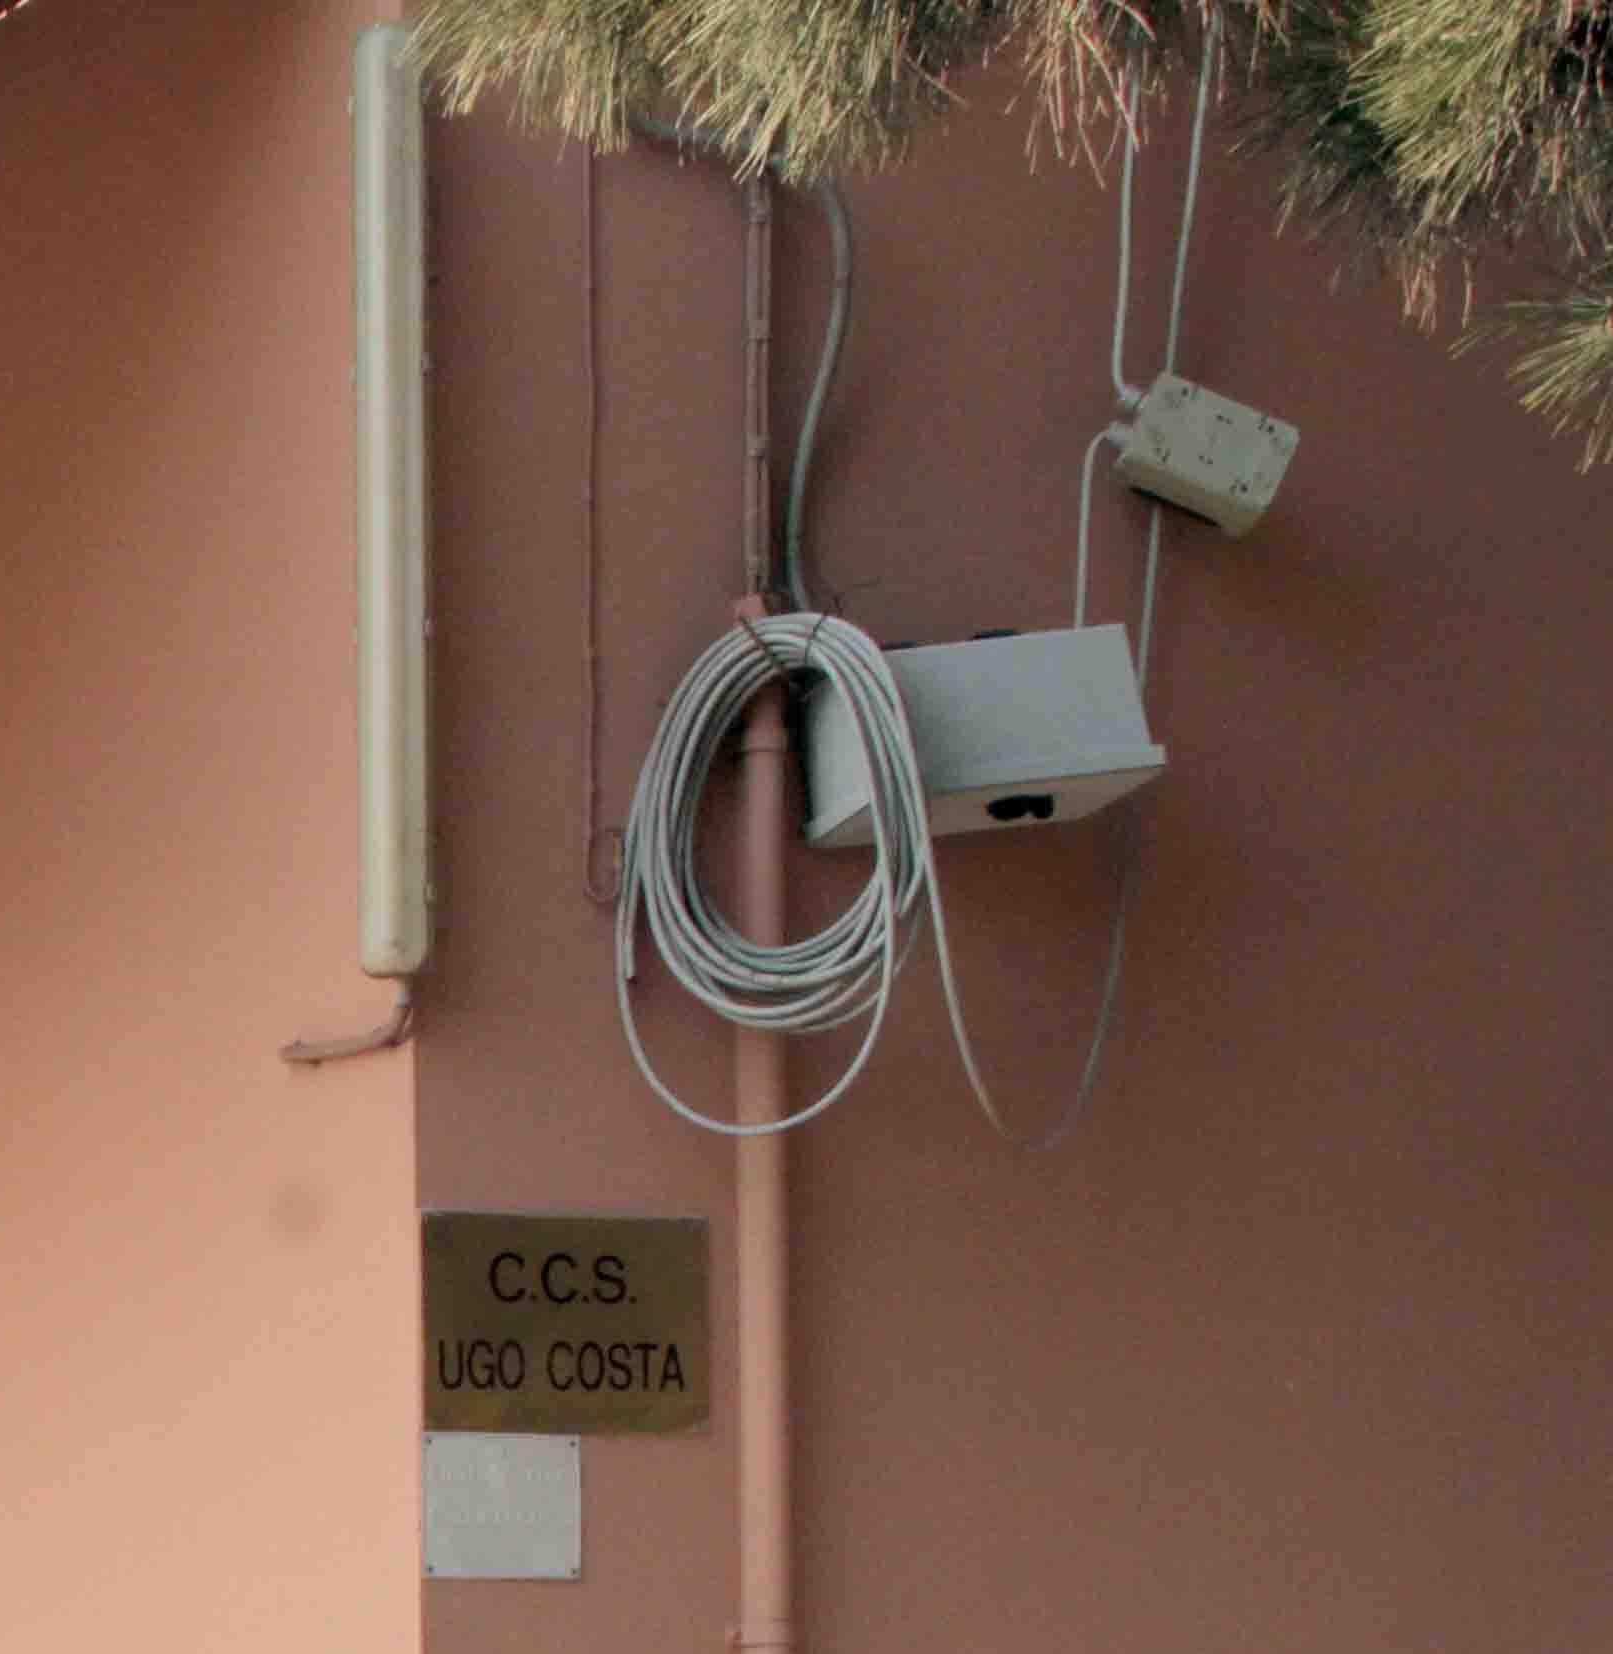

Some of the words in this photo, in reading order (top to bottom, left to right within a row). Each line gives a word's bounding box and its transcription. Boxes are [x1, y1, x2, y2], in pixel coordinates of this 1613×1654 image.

[488, 1251, 638, 1304] C.C.S.
[437, 1338, 526, 1391] UGO
[546, 1340, 685, 1392] COSTA
